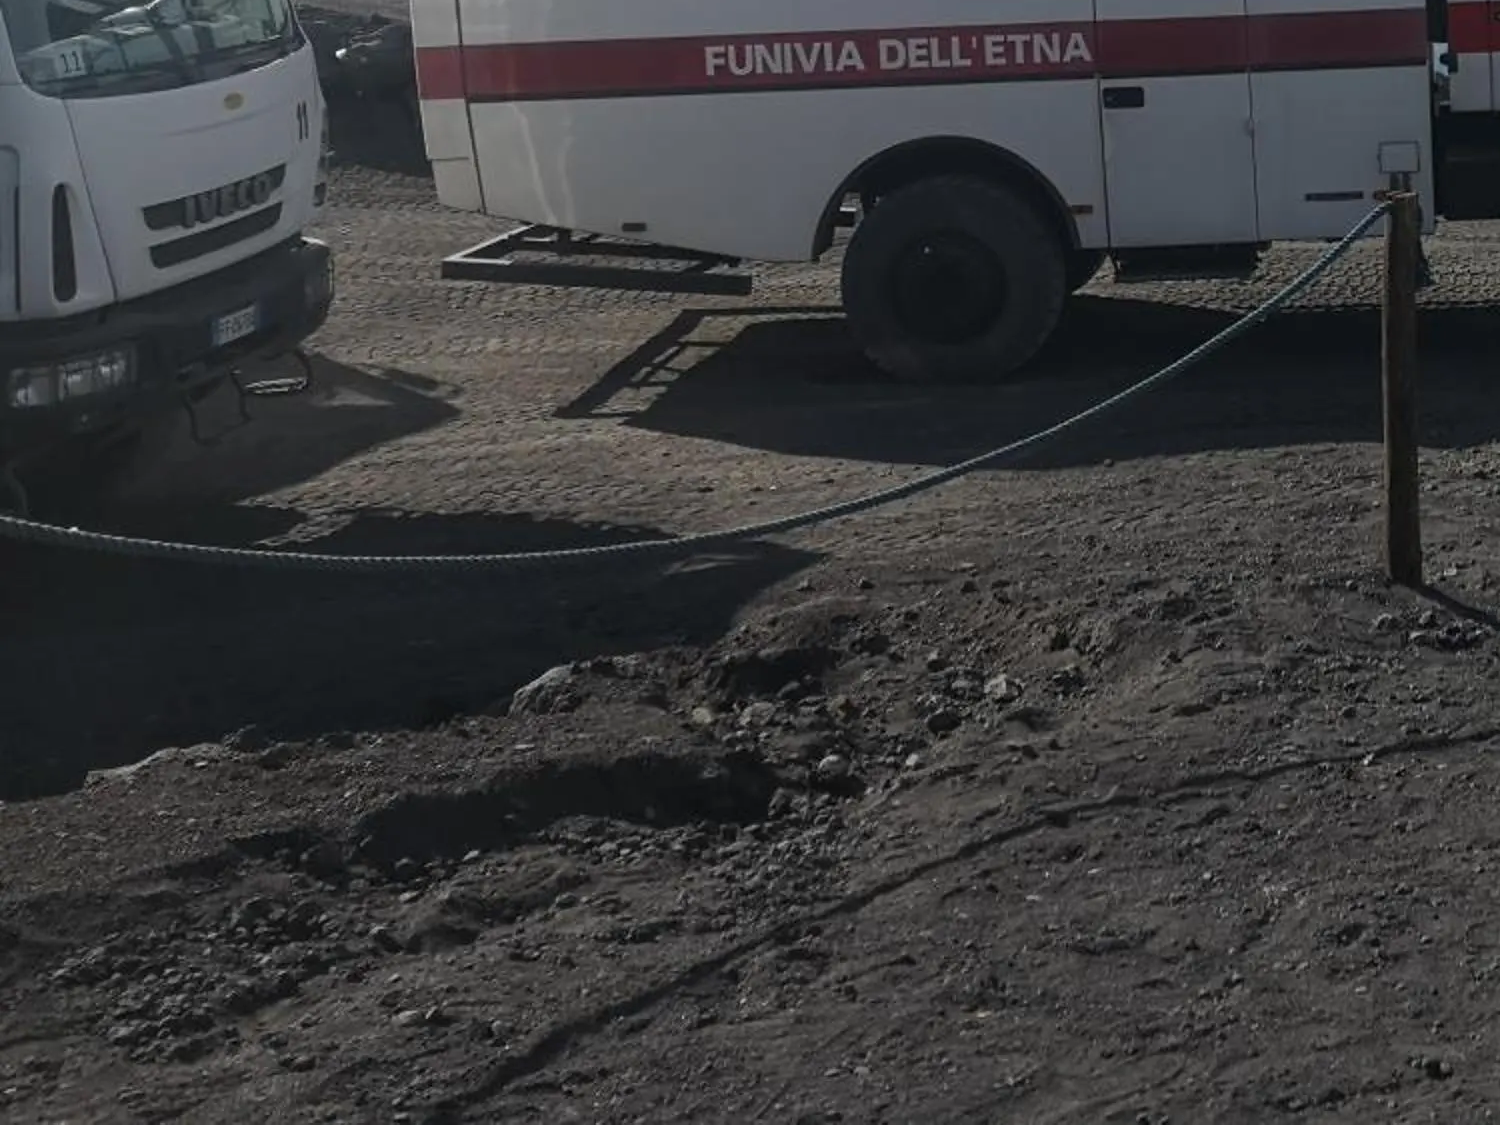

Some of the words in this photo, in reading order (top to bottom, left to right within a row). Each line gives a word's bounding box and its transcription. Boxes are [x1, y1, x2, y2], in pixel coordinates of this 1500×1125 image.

[704, 40, 865, 76] FUNIVIA
[879, 32, 1093, 70] DELL'ETNA
[184, 174, 272, 229] IVECO
